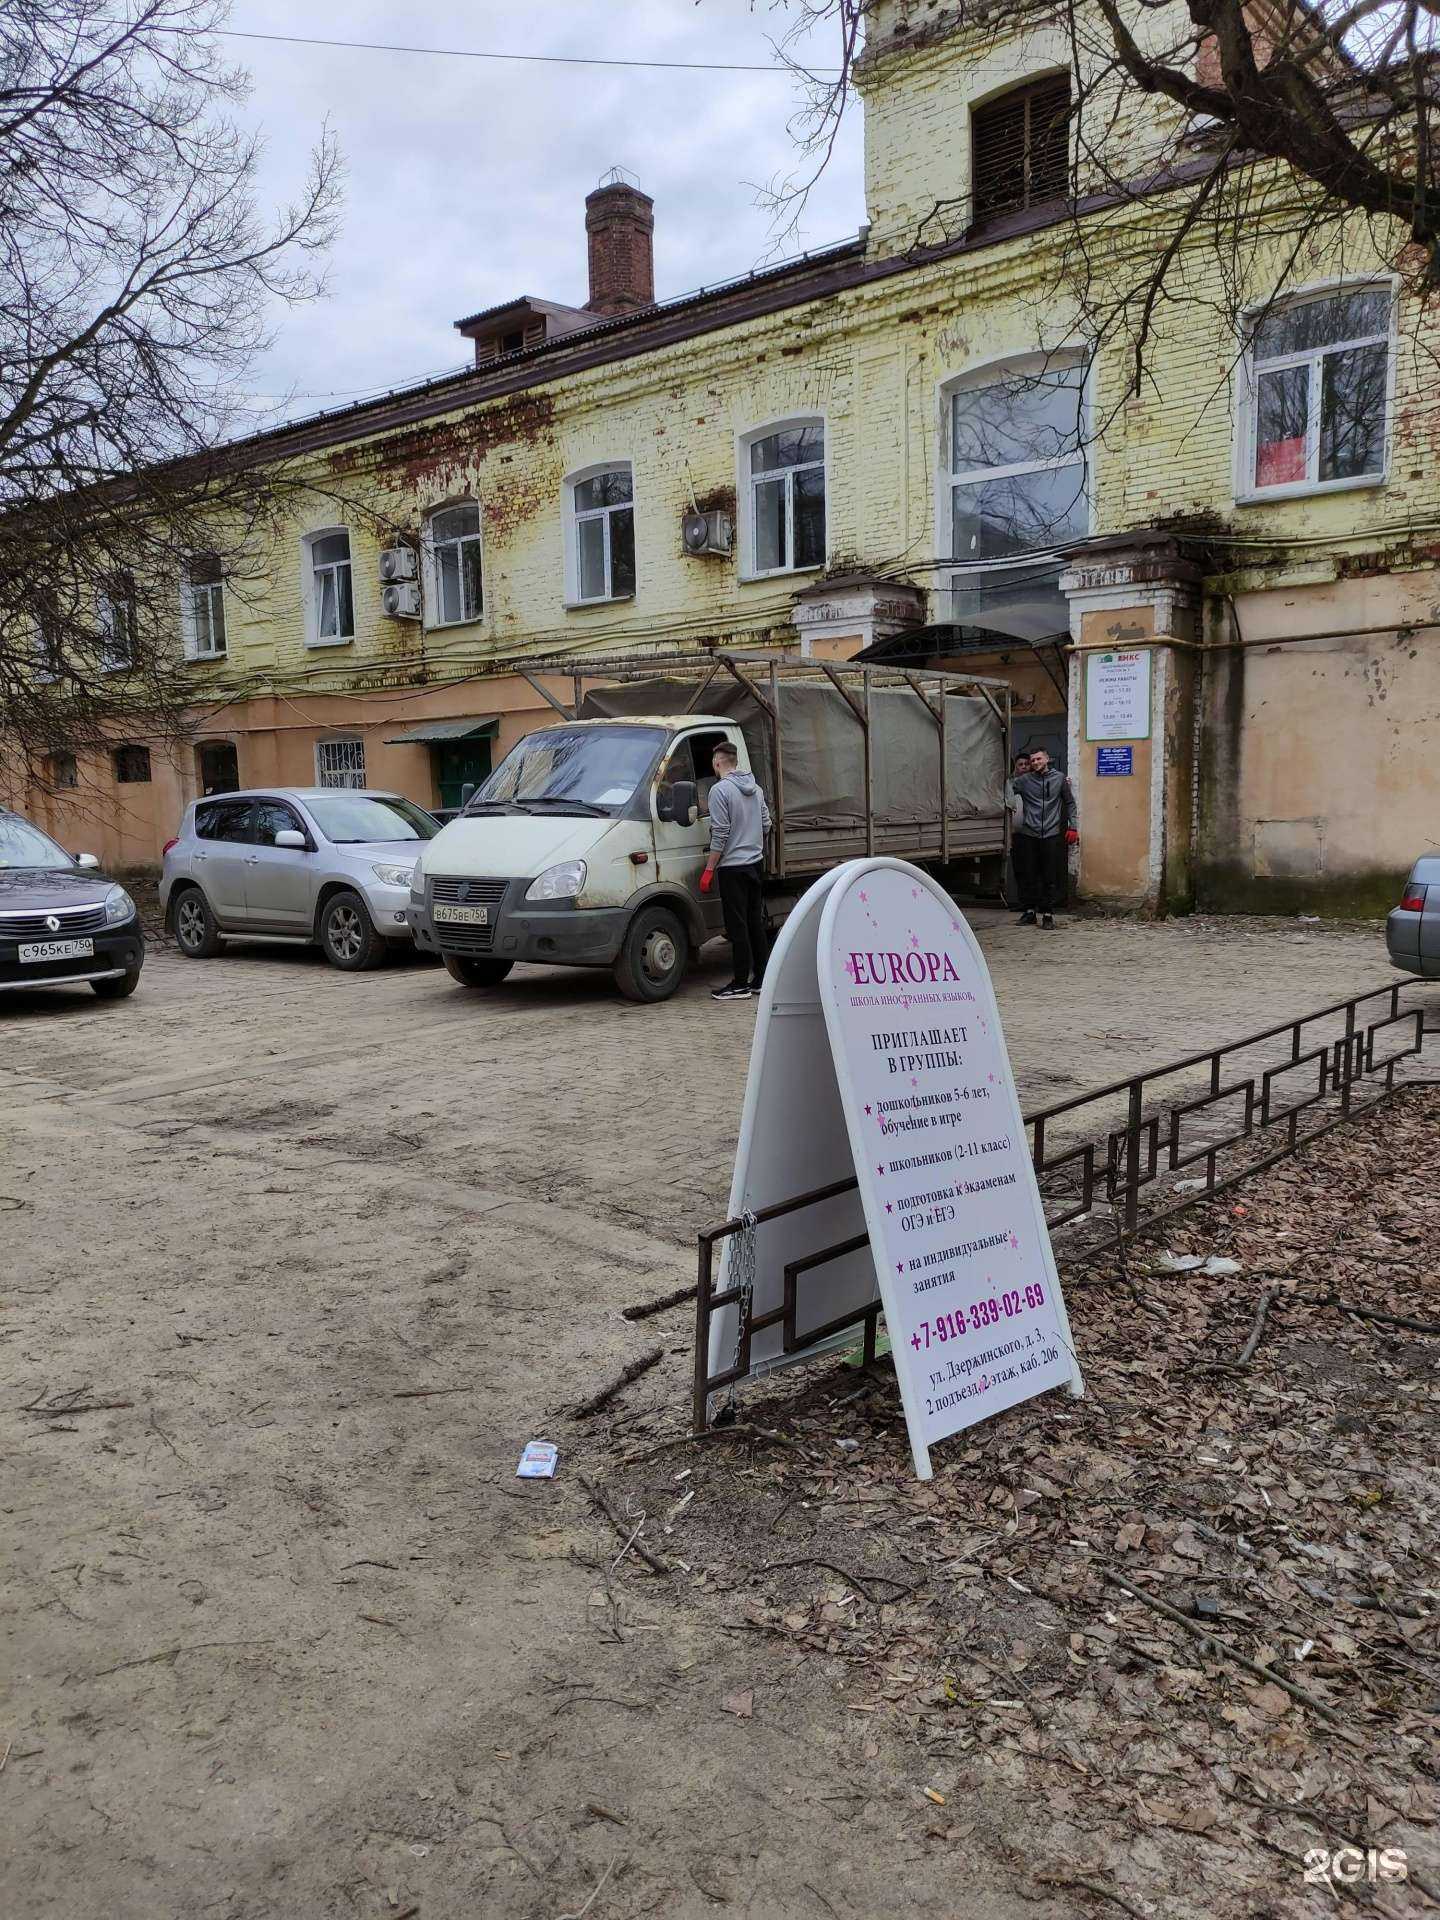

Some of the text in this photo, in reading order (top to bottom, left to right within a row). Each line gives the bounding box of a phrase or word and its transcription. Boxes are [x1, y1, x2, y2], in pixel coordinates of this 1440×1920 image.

[849, 952, 960, 985] EUROPA
[850, 991, 973, 1007] ШКОЛА ИНОСТРАННЫХ ЯЗЫКОВ
[872, 1027, 968, 1050] ПРИГЛАШАЕТ
[888, 1051, 963, 1073] В ГРУППЫ:
[877, 1086, 990, 1114] дошкольников 5-6 лет,
[881, 1111, 963, 1136] обучение в игре
[890, 1136, 1011, 1173] школьников (2-11 класс)
[897, 1173, 1016, 1211] подготовка к экзаменам
[901, 1205, 955, 1232] ОГЭ и ЕГЭ
[909, 1232, 1008, 1271] на индивидуальные
[913, 1270, 956, 1294] занятия
[911, 1283, 1045, 1351] +7-916-339-02-69
[930, 1327, 1046, 1391] ул. Дзержинского, д. 3,
[926, 1345, 1059, 1415] 2 подъезд, 2 этаж, каб. 206
